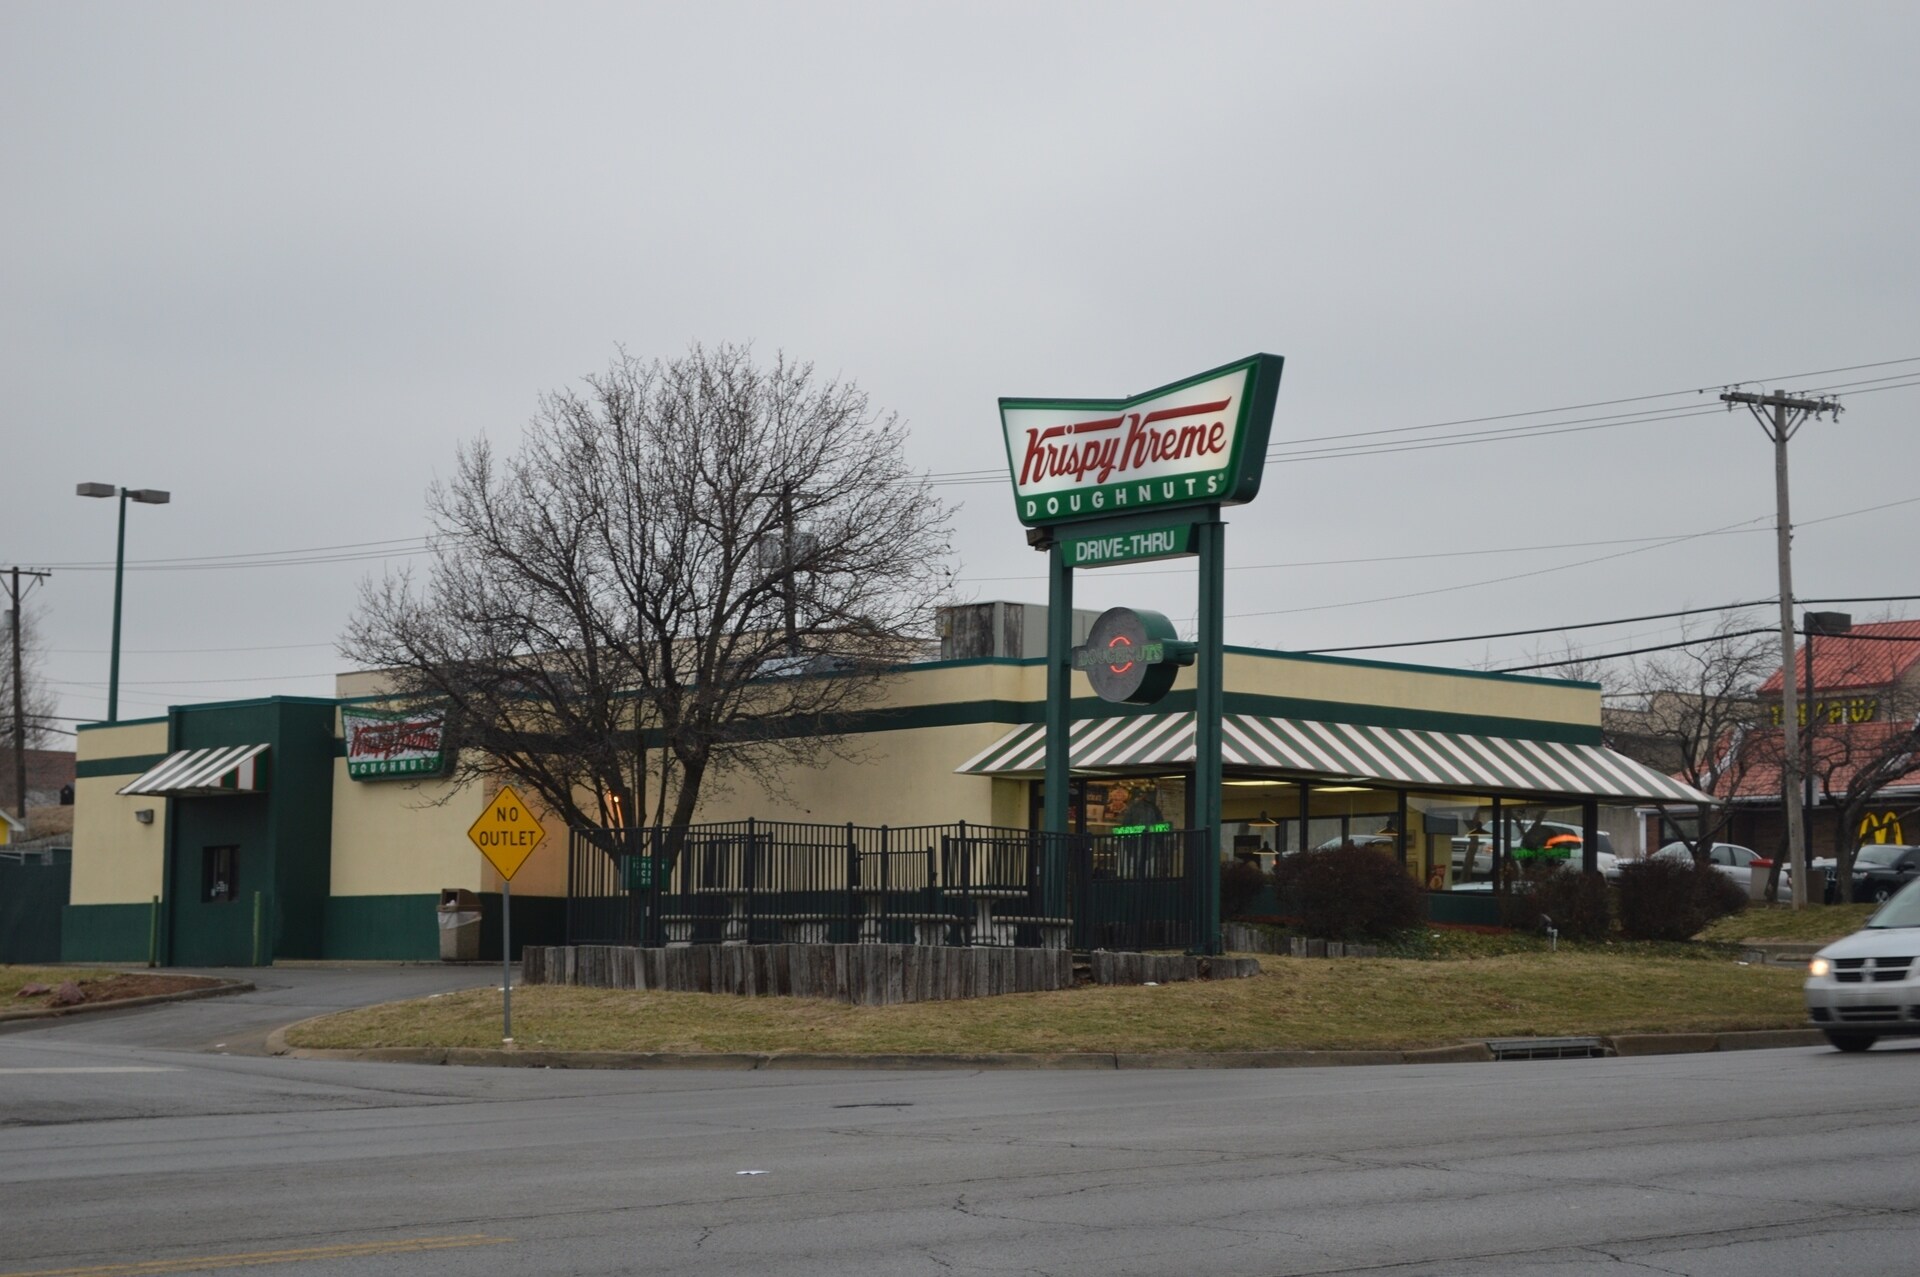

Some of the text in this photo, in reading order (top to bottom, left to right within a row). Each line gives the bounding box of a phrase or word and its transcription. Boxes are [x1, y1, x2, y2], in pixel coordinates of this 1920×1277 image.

[1019, 396, 1232, 485] Krispy Kreme
[1026, 475, 1218, 517] DOUGHNUTS
[1075, 531, 1175, 562] DRIVE-THRU
[496, 806, 519, 822] NO
[479, 830, 536, 847] OUTLET
